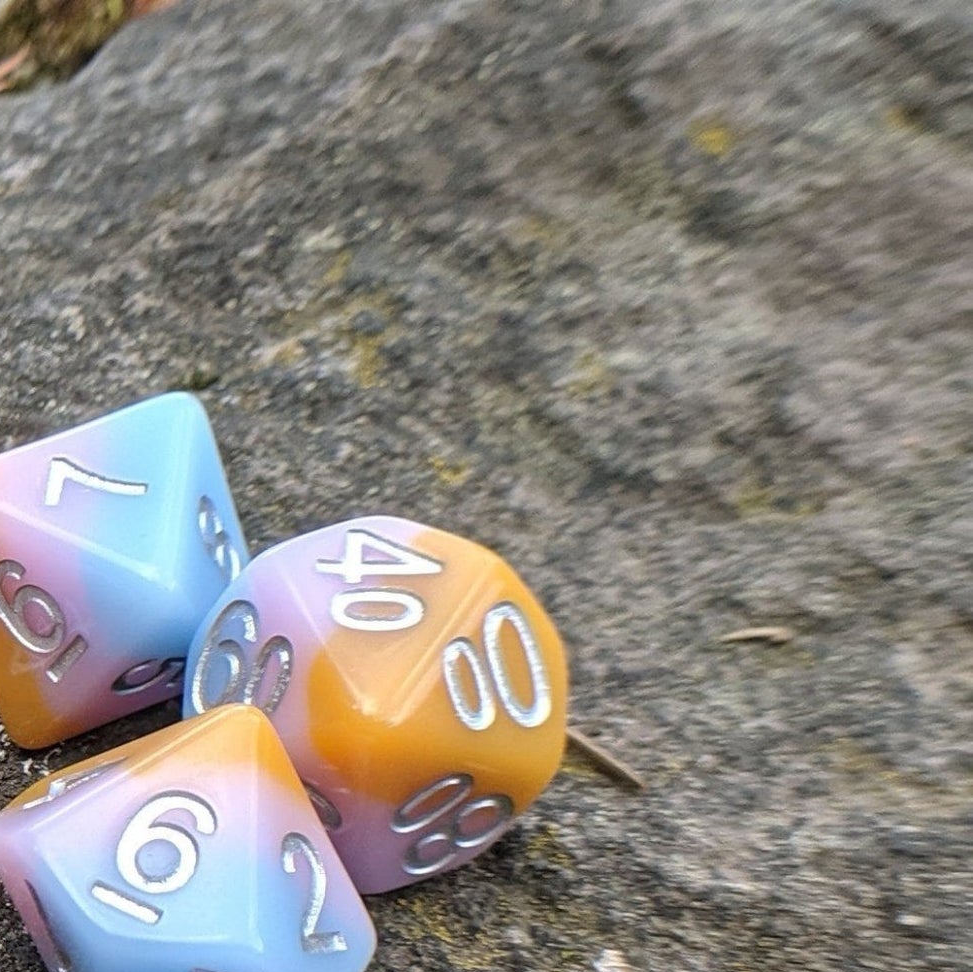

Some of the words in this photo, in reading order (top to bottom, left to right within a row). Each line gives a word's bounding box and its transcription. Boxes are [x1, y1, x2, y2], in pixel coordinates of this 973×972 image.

[44, 456, 149, 507] 7
[315, 529, 443, 632] 40
[443, 601, 552, 731] 00
[390, 773, 515, 876] 80
[280, 831, 348, 953] 2
